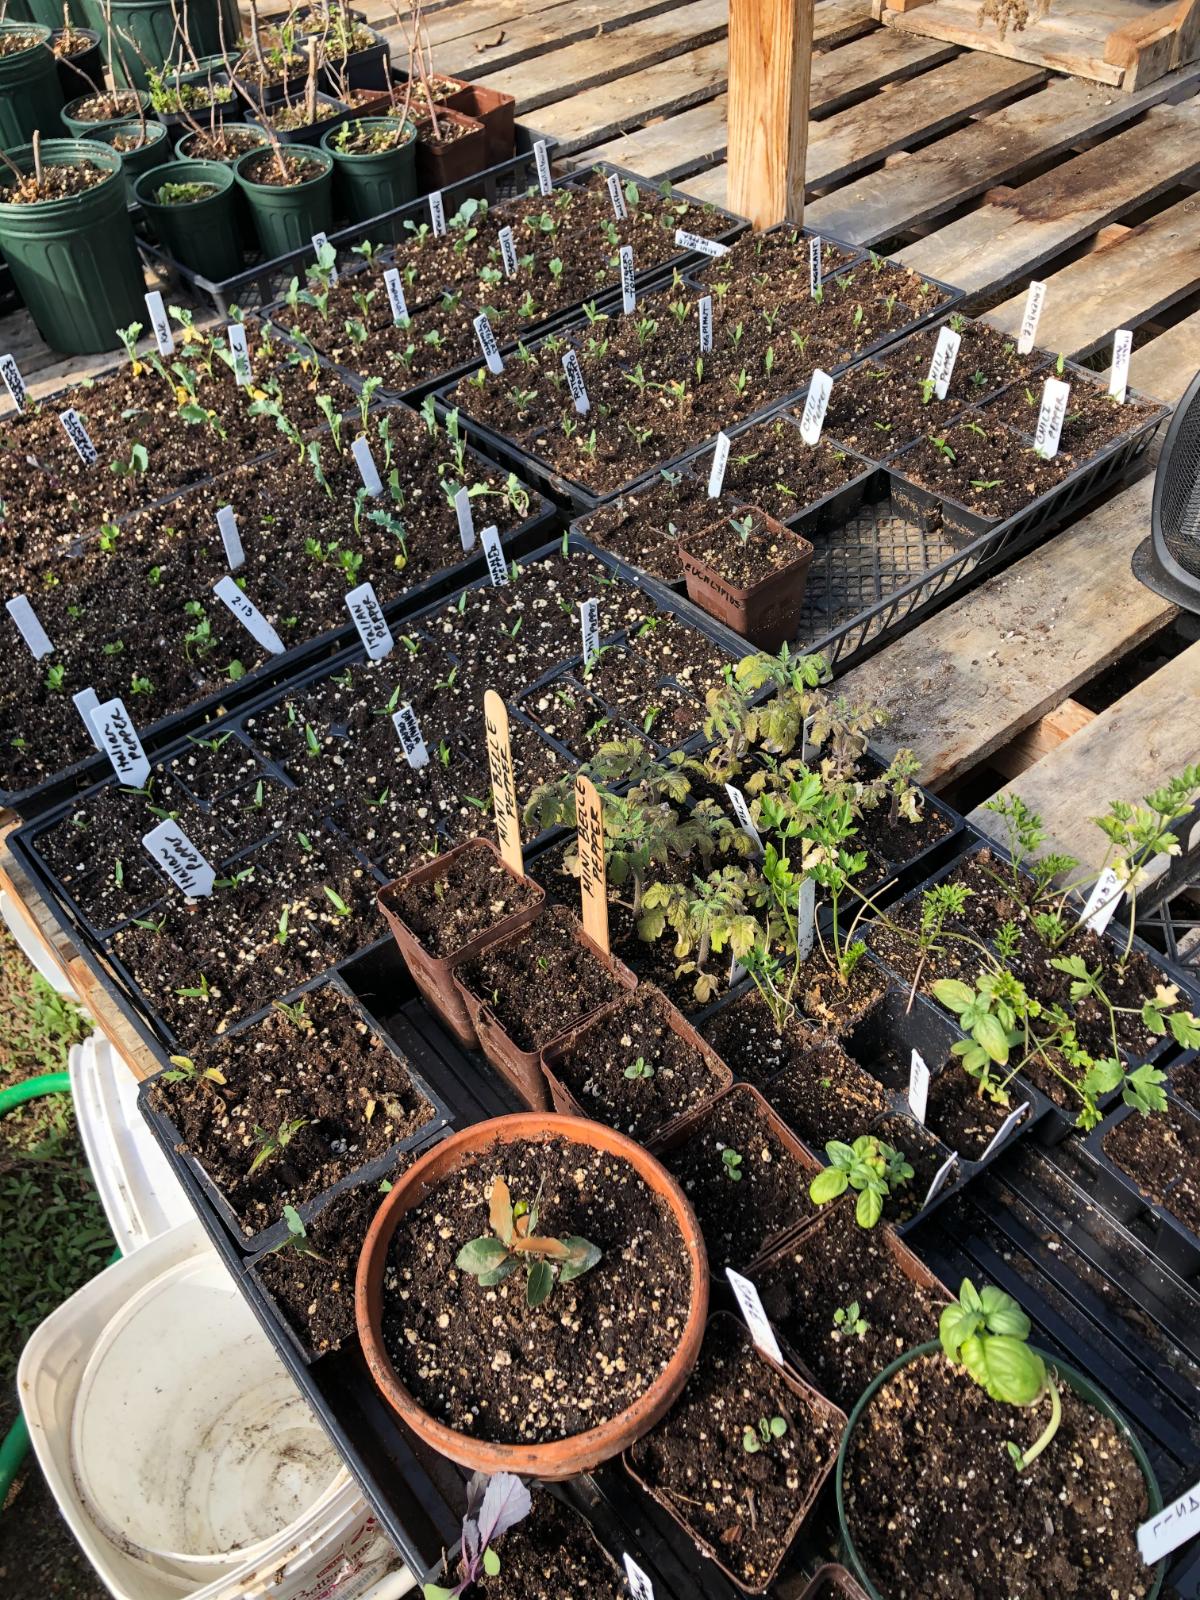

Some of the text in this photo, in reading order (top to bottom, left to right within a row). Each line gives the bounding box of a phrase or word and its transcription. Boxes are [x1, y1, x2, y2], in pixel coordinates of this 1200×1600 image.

[486, 716, 511, 847] MINI BELLE
[500, 742, 516, 820] PEPPER
[576, 778, 595, 898] MINI BELLE
[590, 805, 603, 886] PEPPER
[1153, 1495, 1200, 1538] ASIL
